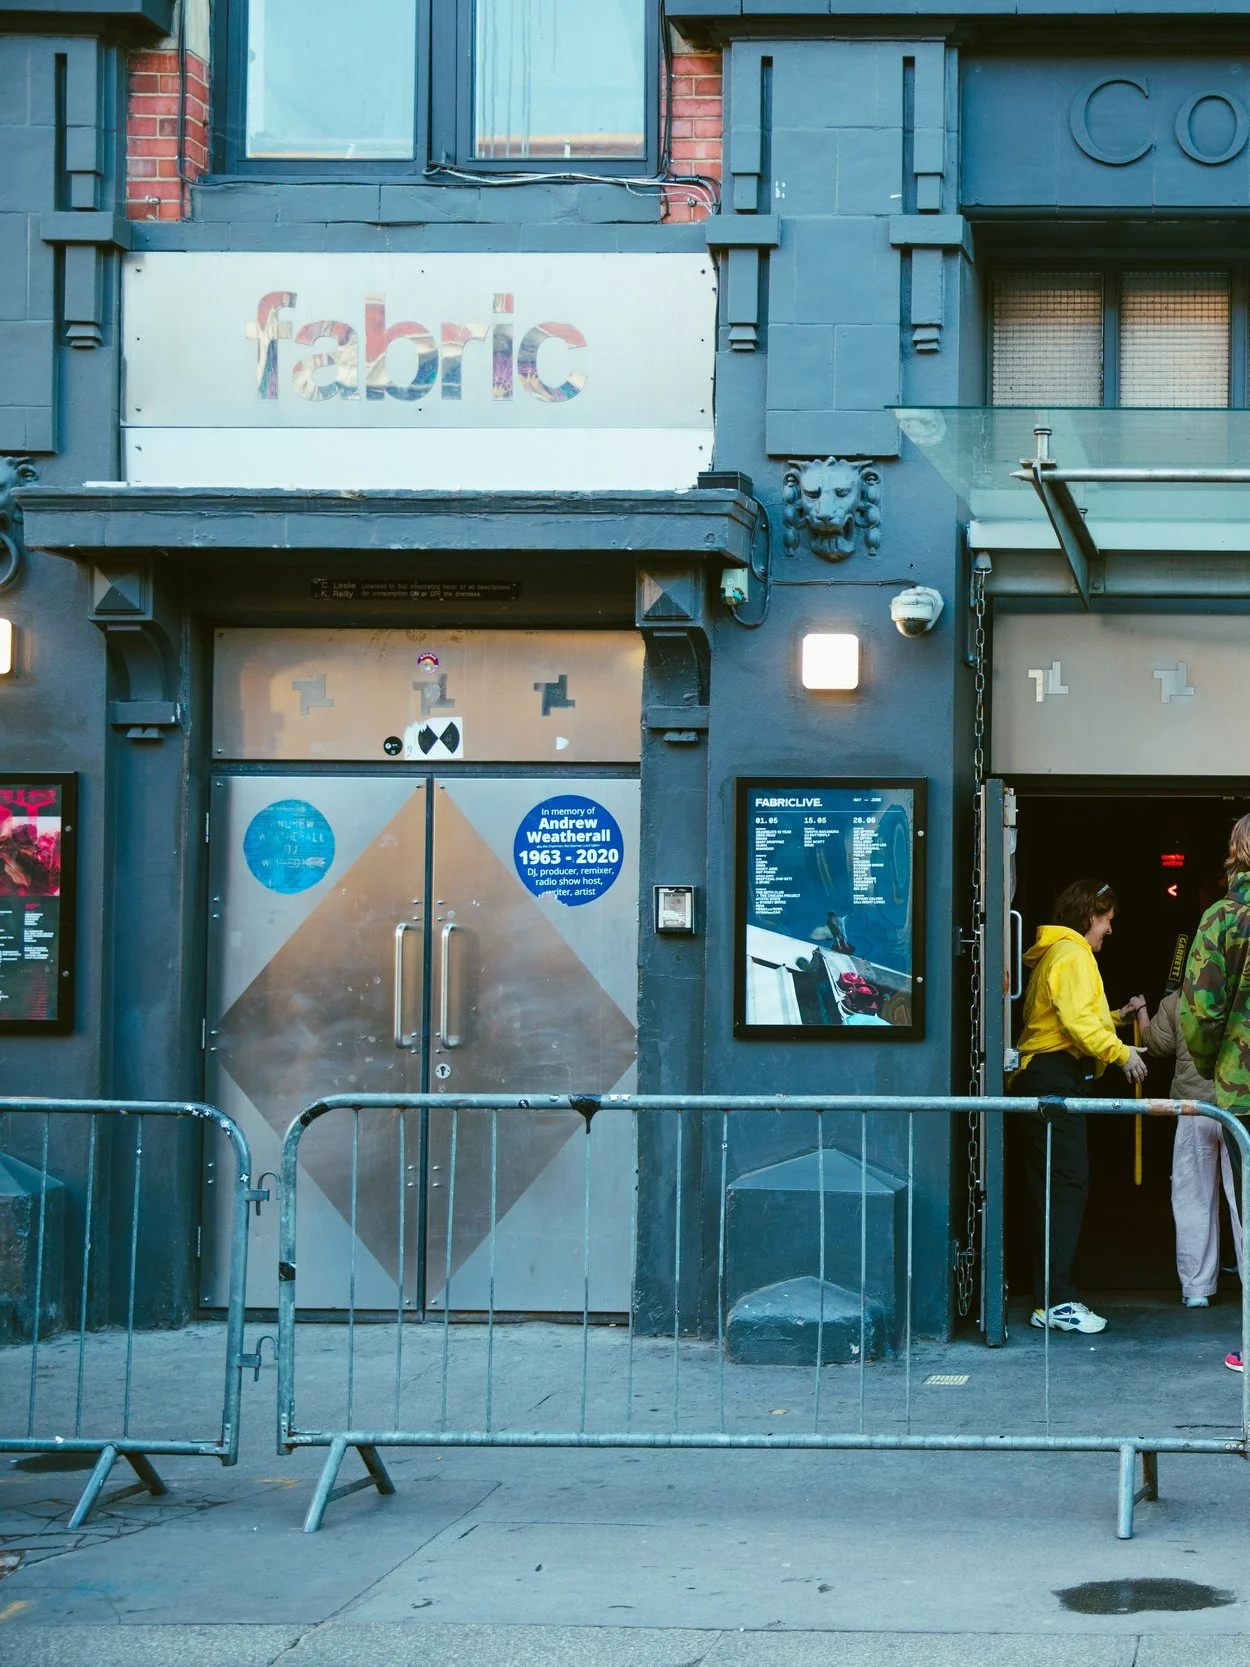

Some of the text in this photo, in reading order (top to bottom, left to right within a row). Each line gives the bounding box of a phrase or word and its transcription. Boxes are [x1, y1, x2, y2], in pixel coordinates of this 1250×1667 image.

[245, 290, 589, 403] fabric
[755, 797, 823, 808] FABRICLIVE.
[541, 806, 596, 817] In memory of
[538, 816, 598, 830] Andrew
[526, 829, 611, 844] Weatherall
[519, 849, 561, 865] 1963
[575, 848, 619, 864] 2020
[527, 867, 615, 877] DJ, producer, remixer,
[535, 876, 603, 886] radio show host,
[574, 887, 596, 896] artist
[1172, 937, 1186, 977] GARRETT
